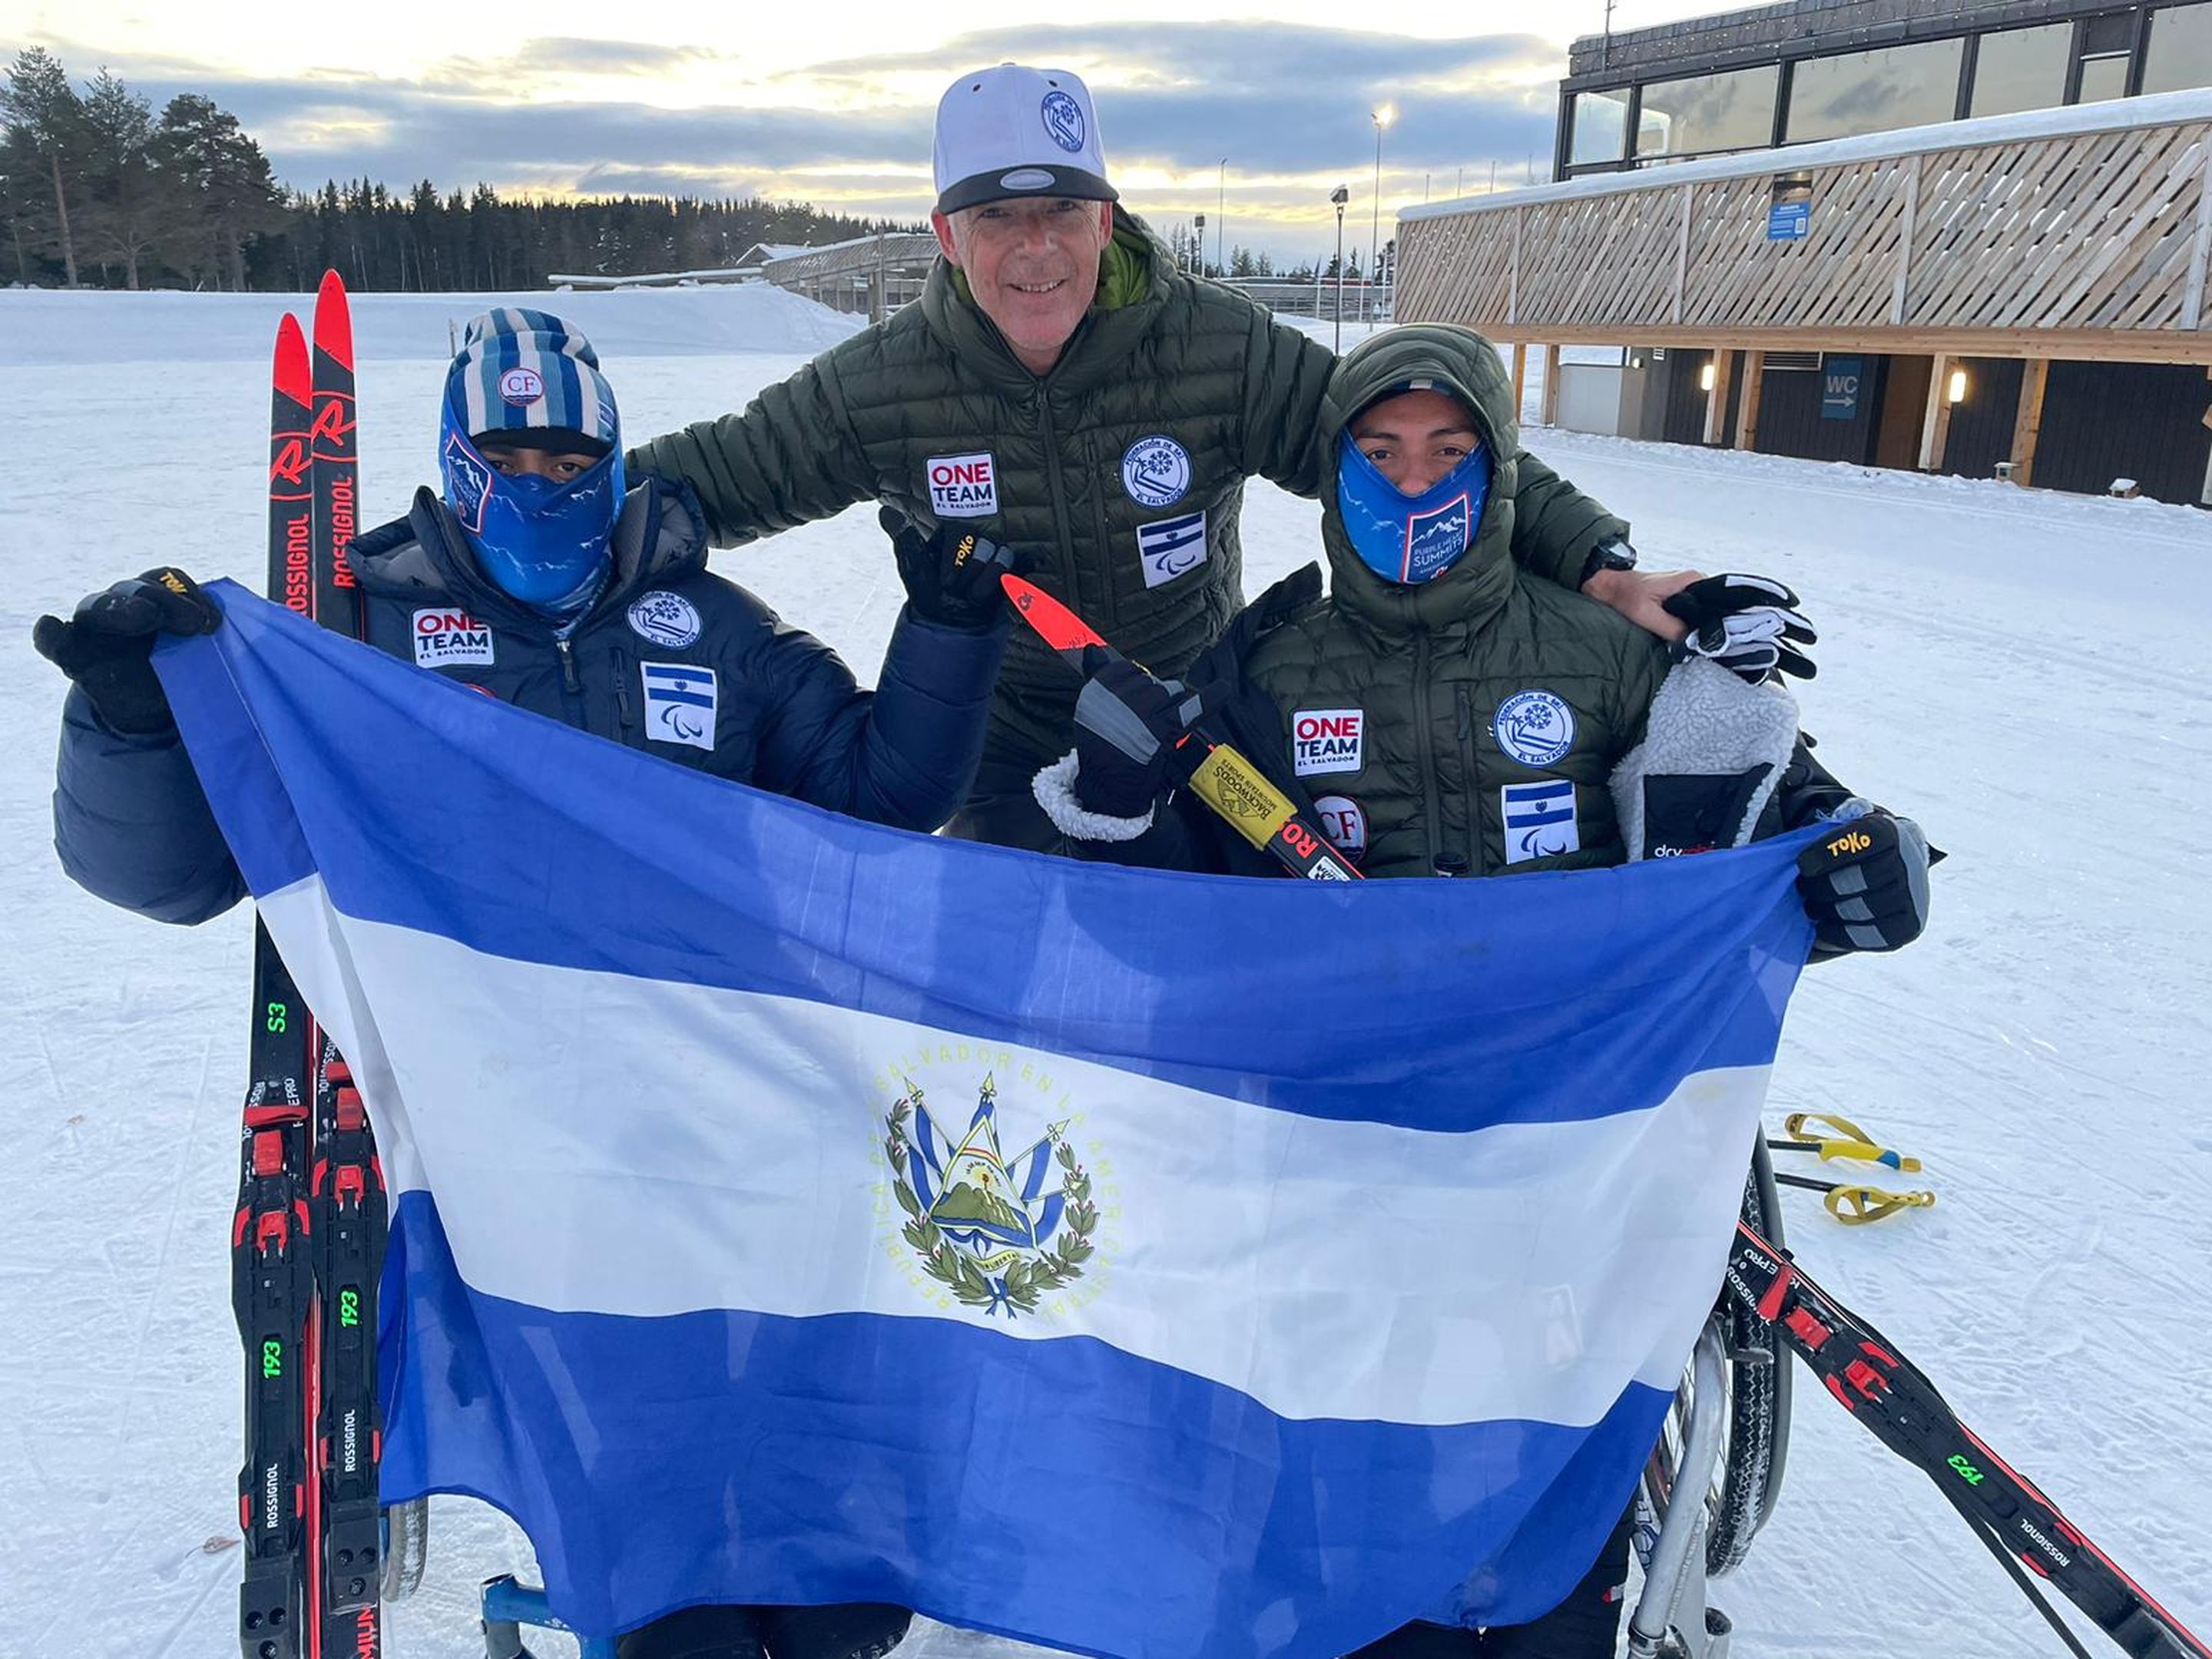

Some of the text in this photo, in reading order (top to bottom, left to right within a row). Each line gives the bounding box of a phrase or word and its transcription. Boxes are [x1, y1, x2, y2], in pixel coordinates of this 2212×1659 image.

[508, 376, 535, 392] CF
[1827, 376, 1858, 394] WC
[932, 462, 991, 486] ONE
[932, 484, 992, 502] TEAM
[1136, 488, 1184, 504] EL SALVADOR
[950, 501, 992, 510] SALVADOR
[954, 534, 975, 568] TOKO
[1413, 535, 1464, 567] SUMMITS
[286, 512, 310, 615] OSSIGNOL
[417, 614, 488, 634] ONE
[417, 632, 489, 651] TEAM
[436, 648, 487, 657] SALVADOR
[1296, 717, 1360, 740] ONE
[1296, 737, 1358, 758] TEAM
[1518, 740, 1569, 763] EL SALVADOR
[1311, 756, 1355, 766] SALVADOR
[1213, 765, 1273, 821] BACKWOODS
[1243, 780, 1278, 811] MOUNTAIN
[1826, 832, 1871, 857] TOKO
[268, 1002, 286, 1034] S3
[341, 1290, 358, 1327] 193
[263, 1340, 281, 1379] 193
[345, 1409, 356, 1472] ROSSIGNOL
[1947, 1454, 1984, 1487] 193
[267, 1463, 279, 1529] ROSSIGNOL
[2019, 1518, 2071, 1568] ROSSIGNOL
